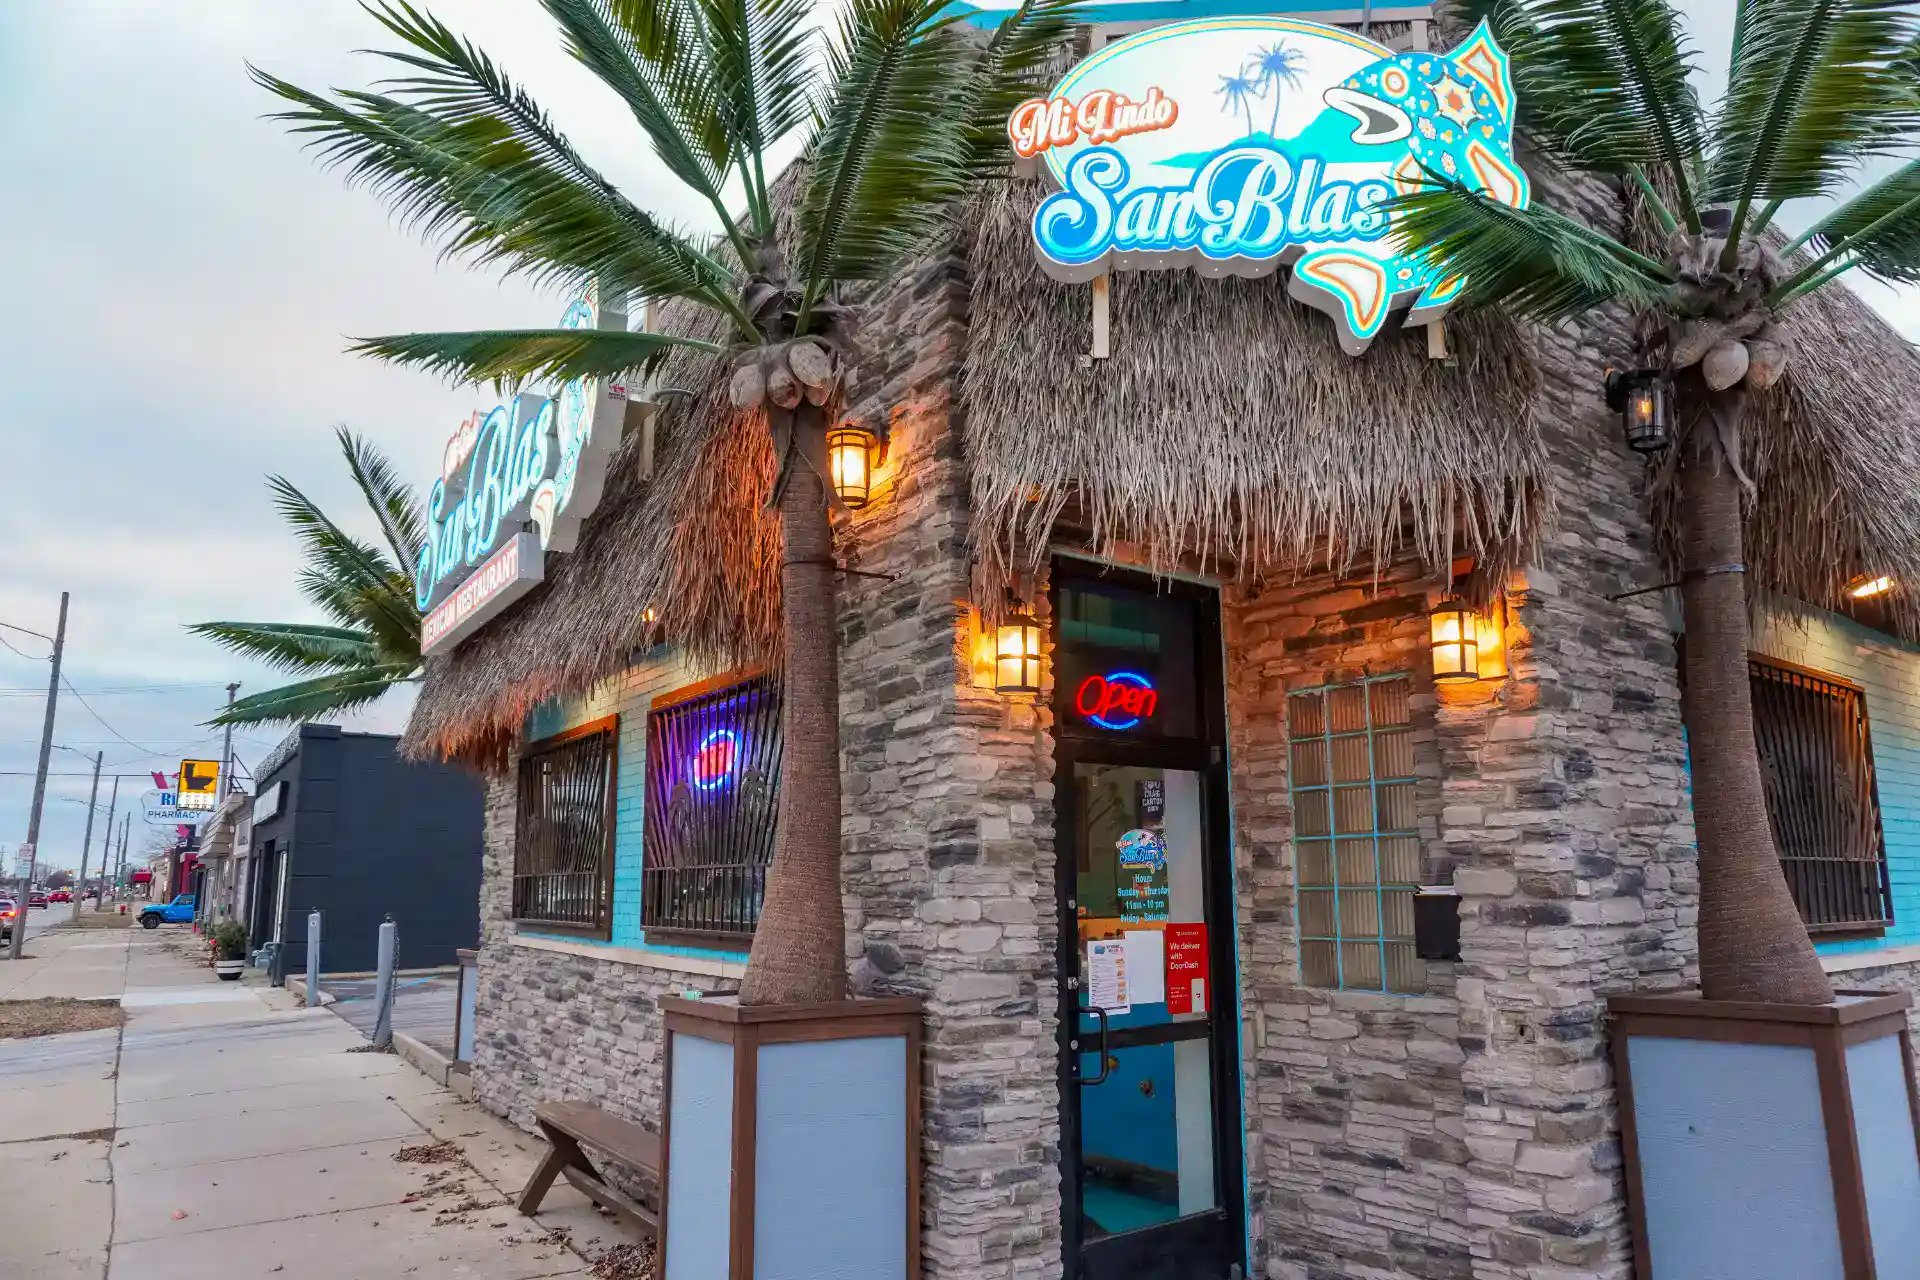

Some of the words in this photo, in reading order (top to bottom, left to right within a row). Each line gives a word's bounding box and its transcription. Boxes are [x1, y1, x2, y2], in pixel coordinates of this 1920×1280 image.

[1010, 98, 1075, 154] Mi
[1077, 87, 1178, 143] Lindo
[1037, 149, 1198, 262] San
[1195, 147, 1394, 252] Blas
[422, 600, 456, 646] MEXICAN
[456, 547, 517, 619] RESTAURANT
[1077, 675, 1157, 720] Open
[148, 810, 202, 819] PHARMACY
[1135, 874, 1153, 883] Hours
[1117, 887, 1140, 898] Sunday
[1126, 900, 1142, 909] 11am
[1120, 913, 1139, 924] Friday
[1144, 912, 1169, 922] Saturday
[1181, 942, 1200, 950] deliver
[1170, 952, 1183, 960] with
[1170, 961, 1199, 970] DoorDash
